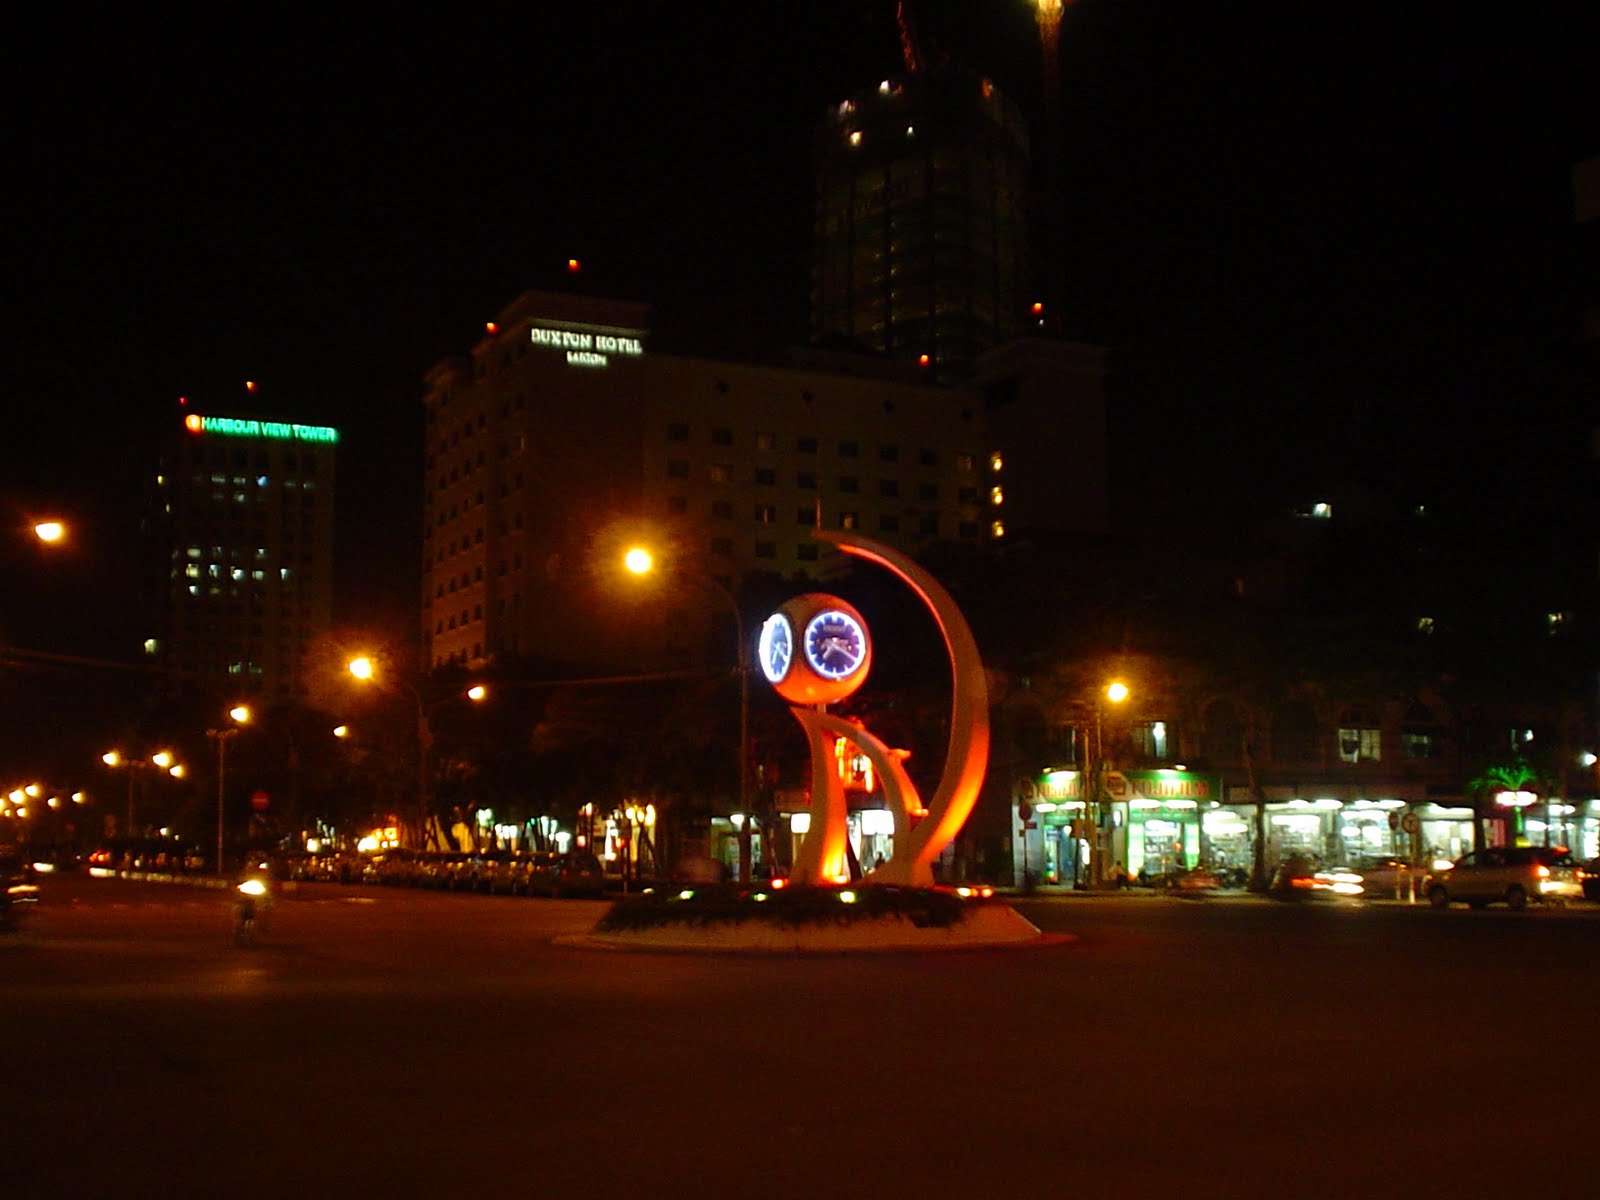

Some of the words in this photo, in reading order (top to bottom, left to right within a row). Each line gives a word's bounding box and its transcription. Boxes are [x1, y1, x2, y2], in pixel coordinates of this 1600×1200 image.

[531, 327, 592, 349] DUXTON
[596, 334, 643, 354] HOTEL
[201, 416, 259, 434] HARBOUR
[260, 421, 292, 438] VIEW
[292, 424, 337, 441] TOWER
